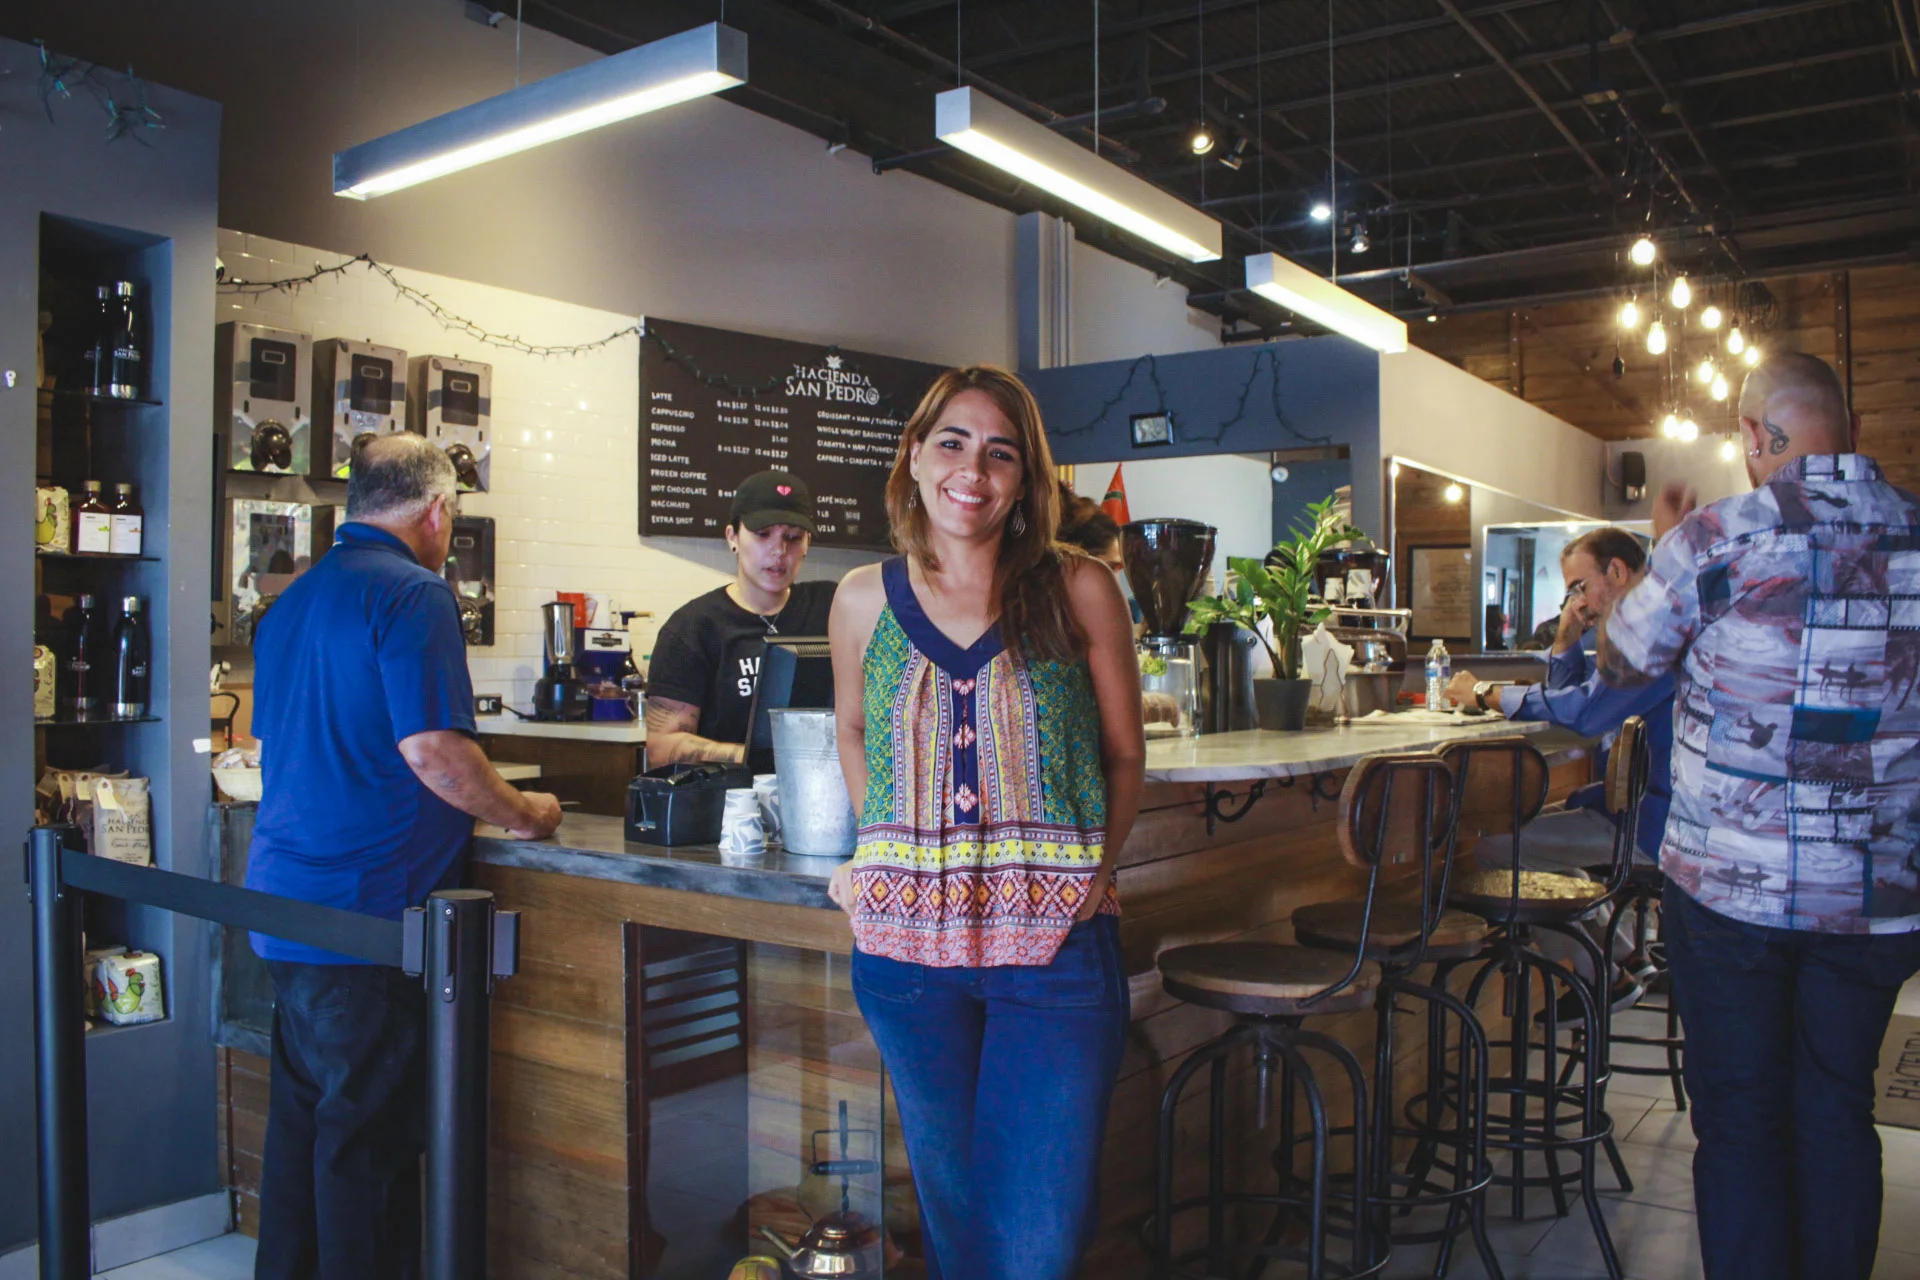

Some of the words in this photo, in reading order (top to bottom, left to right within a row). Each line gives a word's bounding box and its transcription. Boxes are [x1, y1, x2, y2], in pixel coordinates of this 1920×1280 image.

[793, 364, 871, 387] HACIENDA
[785, 375, 820, 398] SAN
[825, 381, 880, 405] PEDRO
[651, 391, 673, 401] LATTE
[817, 411, 850, 420] CROISSANT
[651, 422, 686, 433] ESPRESSO
[817, 425, 839, 435] WHOLE
[840, 427, 861, 437] WHEAT
[651, 437, 677, 447] MOCHA
[650, 453, 667, 462] ICED
[668, 455, 690, 465] LATTE
[650, 469, 678, 479] FROZEN
[680, 471, 707, 481] COFFEE
[651, 485, 665, 493] HOT
[667, 485, 708, 496] CHOCOLATE
[651, 500, 690, 509] MACCHIATO
[651, 515, 674, 524] EXTRA
[675, 516, 694, 525] SHOT
